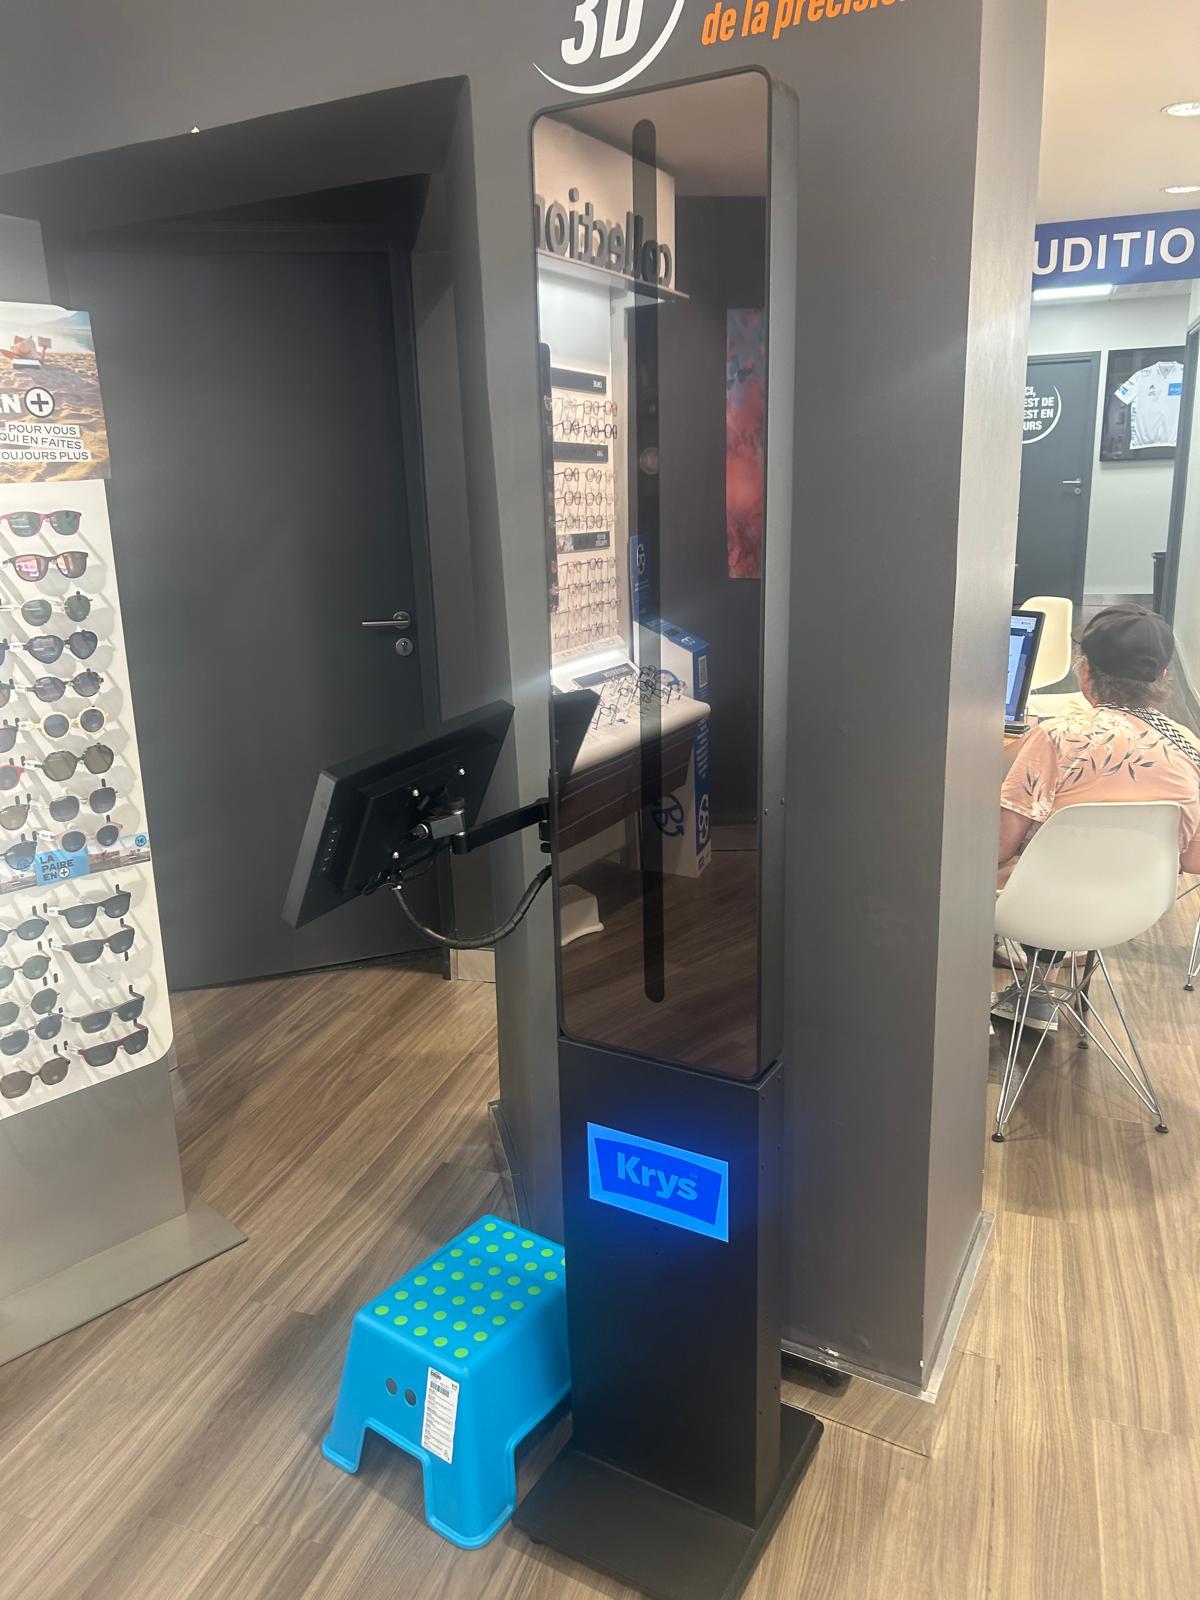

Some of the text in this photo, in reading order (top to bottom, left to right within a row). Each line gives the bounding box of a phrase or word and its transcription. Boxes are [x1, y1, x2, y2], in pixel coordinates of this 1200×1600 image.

[701, 2, 737, 45] de
[741, 0, 770, 37] la
[1032, 227, 1200, 276] UDITIO
[0, 393, 22, 414] N
[1041, 396, 1055, 407] DE
[1040, 408, 1054, 419] EN
[8, 424, 77, 436] POUR VOUS
[0, 433, 82, 450] QUI EN FAITES
[0, 451, 89, 461] OUJOURS PLUS
[39, 854, 55, 865] LA
[41, 858, 75, 874] PAIRE
[43, 871, 58, 882] EN
[617, 1151, 698, 1201] Krys
